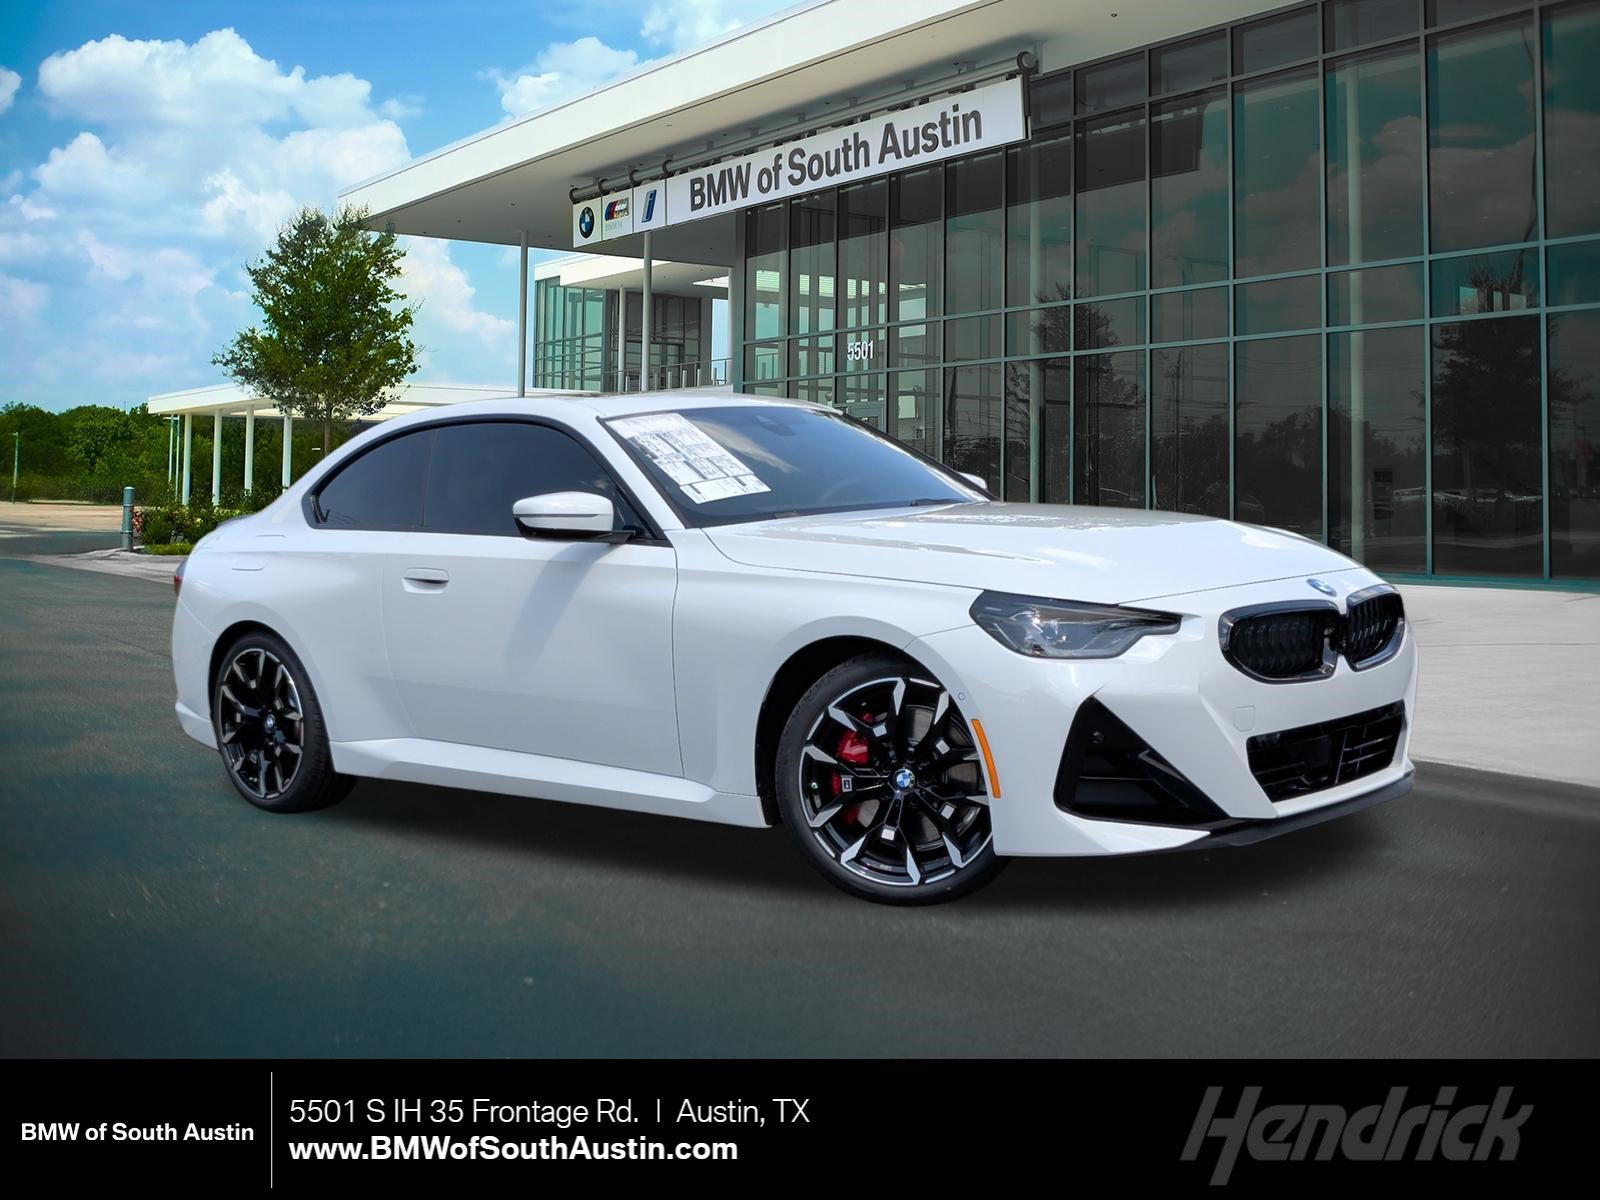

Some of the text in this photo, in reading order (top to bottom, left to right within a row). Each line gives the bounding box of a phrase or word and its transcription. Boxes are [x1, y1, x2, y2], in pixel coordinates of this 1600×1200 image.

[690, 103, 983, 212] BMW of South Austin
[847, 340, 874, 361] 5501
